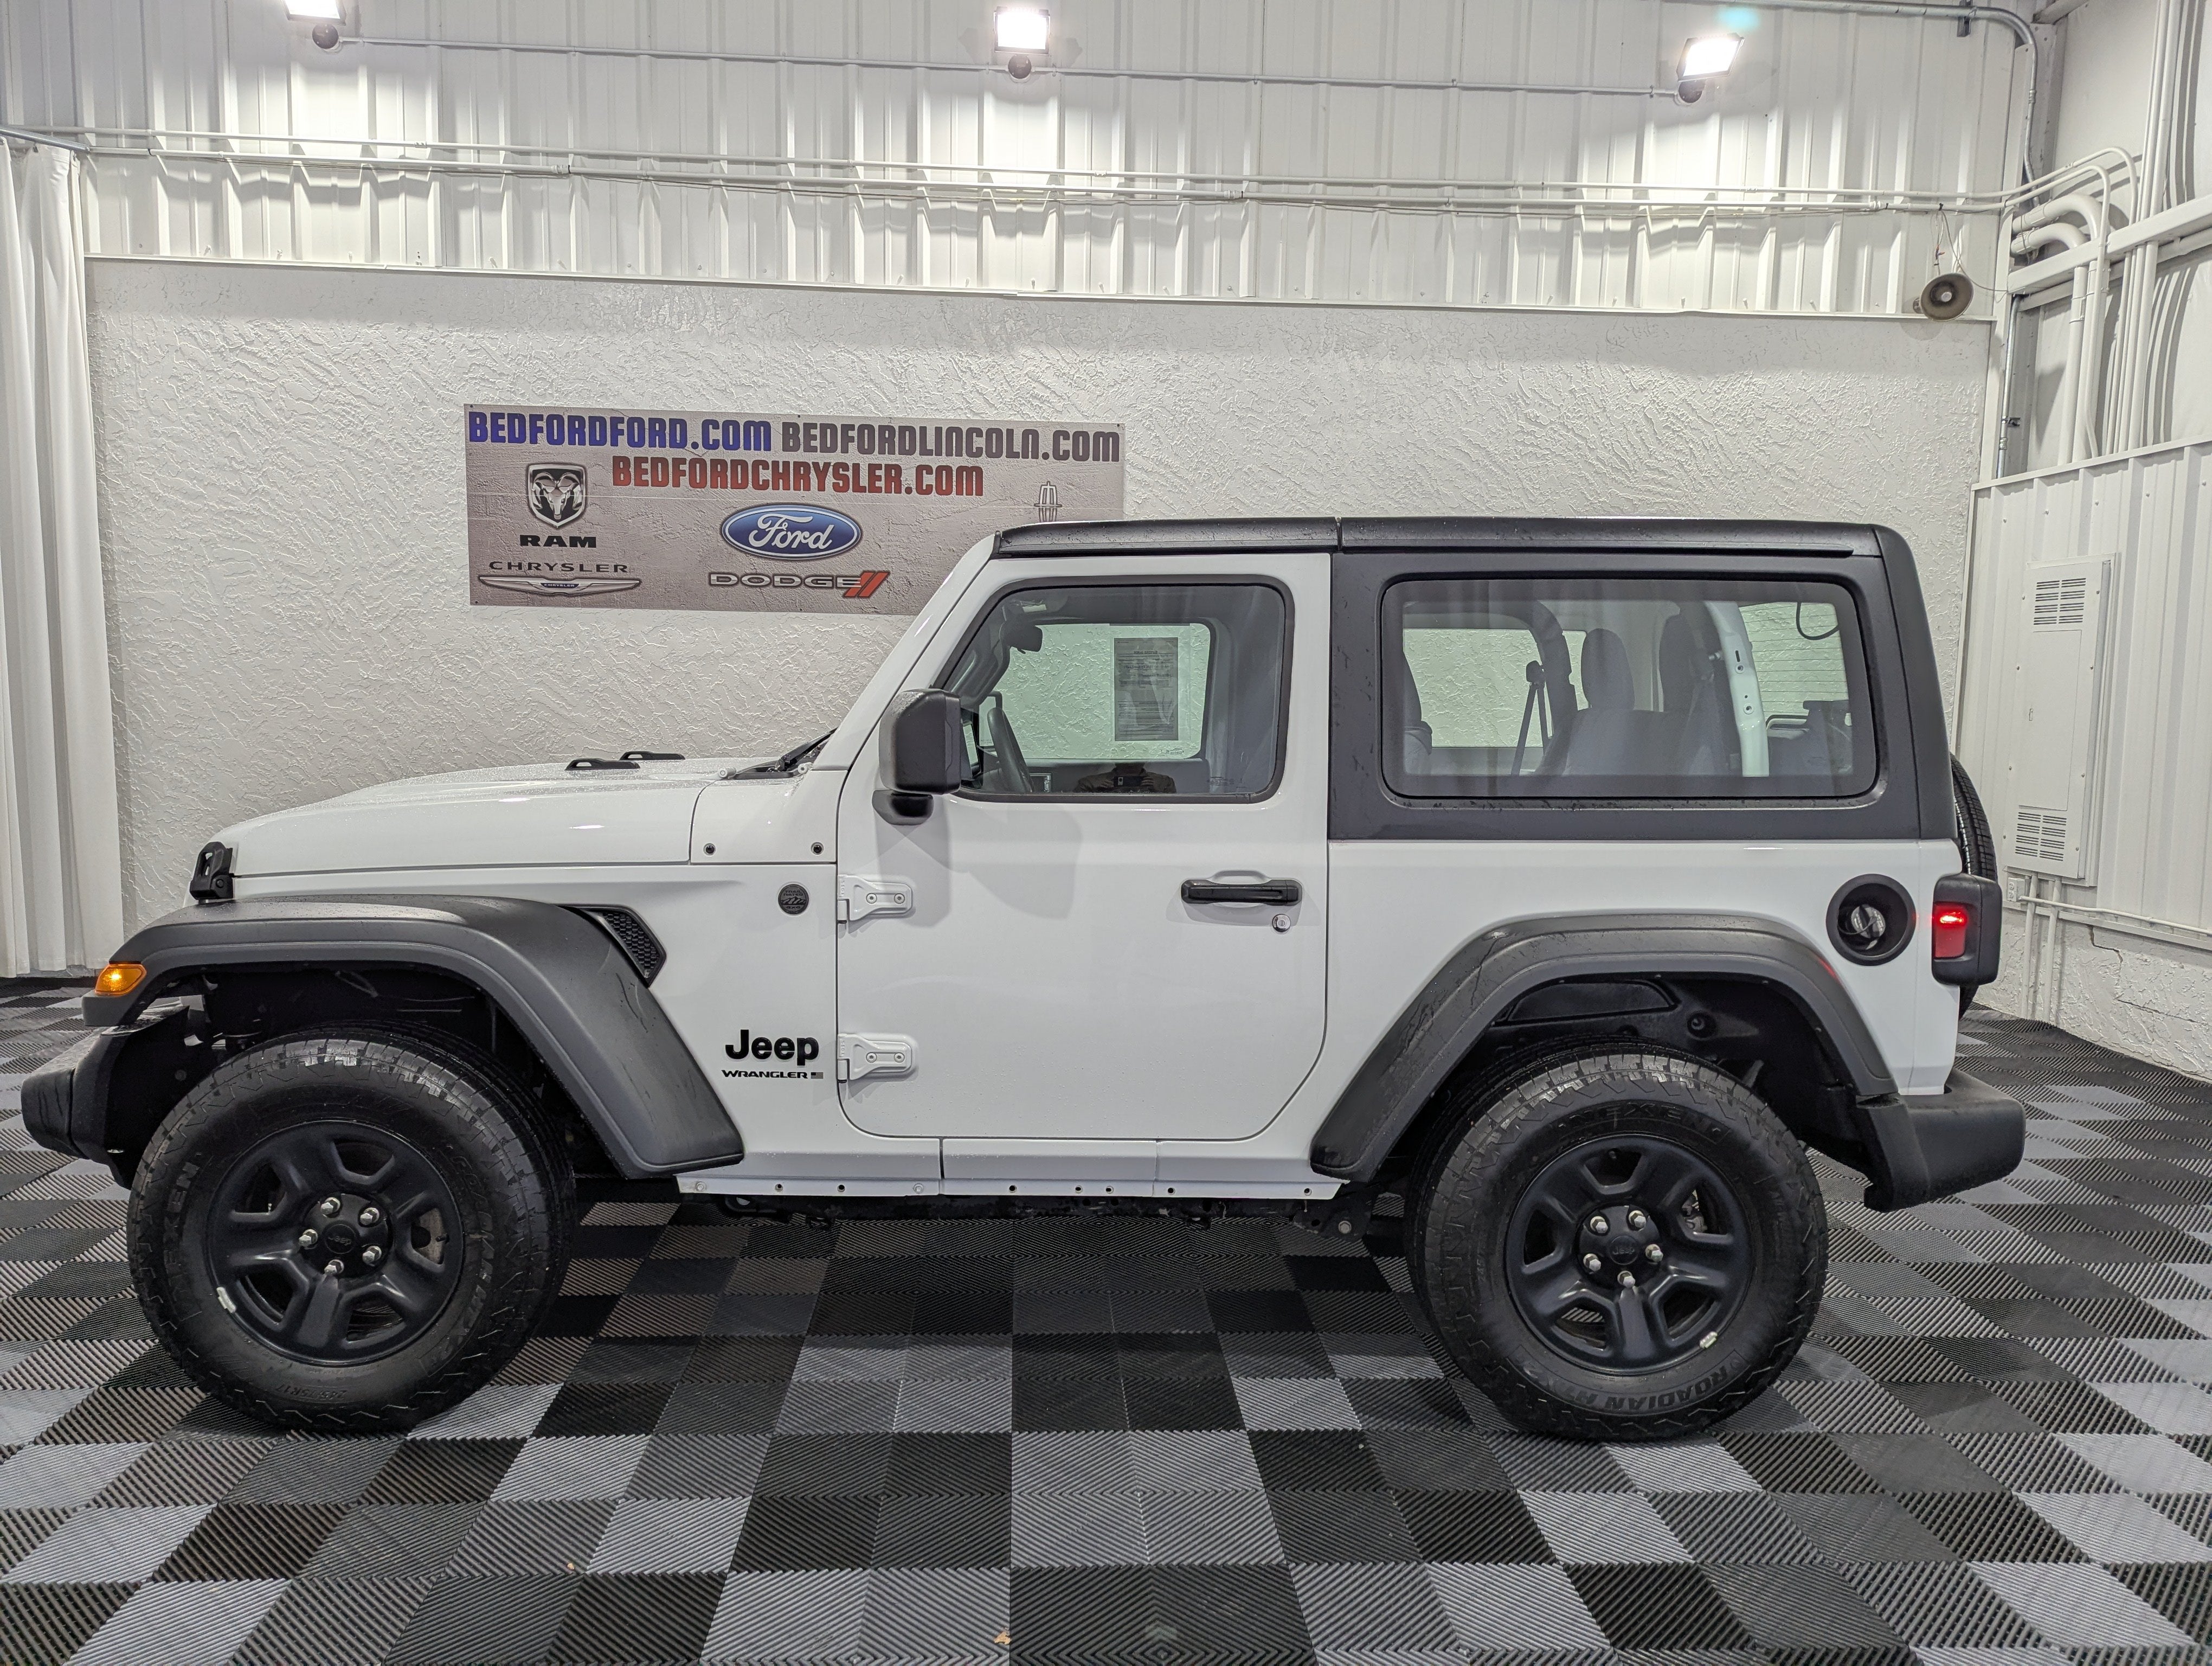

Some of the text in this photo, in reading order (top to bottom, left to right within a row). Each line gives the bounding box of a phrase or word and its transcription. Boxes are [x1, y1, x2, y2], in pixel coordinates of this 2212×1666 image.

[468, 411, 1120, 462] BEDFORDFORD.COM BEDFORDLINCOLN.COM
[612, 456, 983, 496] BEDFORDCHRYSLER.COM
[519, 534, 597, 548] RAM
[748, 513, 835, 549] Ford
[489, 561, 628, 573] CHRYSLER
[710, 573, 862, 589] DODGE
[725, 1029, 819, 1066] Jeep
[721, 1069, 808, 1079] WRANGLER
[1604, 1366, 1728, 1411] ROADIAN
